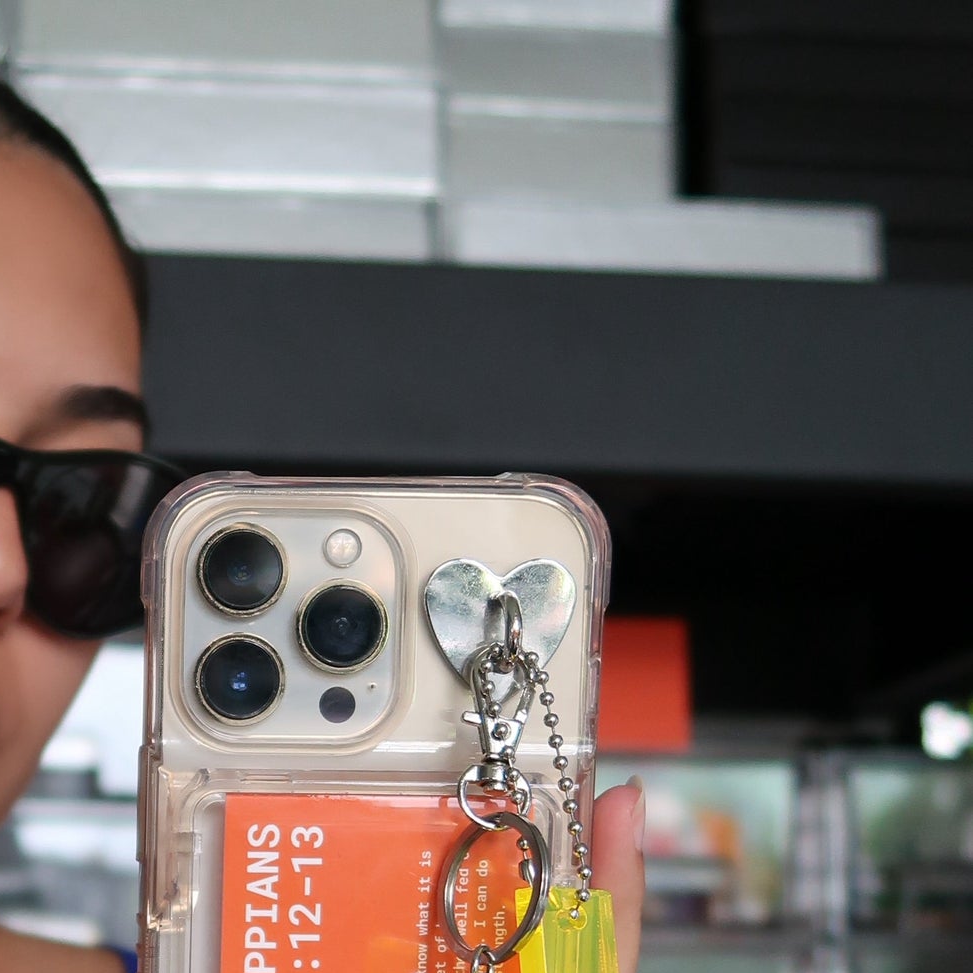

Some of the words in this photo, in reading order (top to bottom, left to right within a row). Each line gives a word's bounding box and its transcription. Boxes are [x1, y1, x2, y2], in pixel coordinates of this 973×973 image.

[418, 850, 432, 867] is
[476, 859, 489, 877] do
[417, 876, 431, 892] it
[456, 868, 469, 894] fed
[476, 885, 488, 911] can
[415, 902, 429, 936] what
[454, 902, 468, 937] well
[473, 919, 486, 928] I
[434, 935, 447, 953] of
